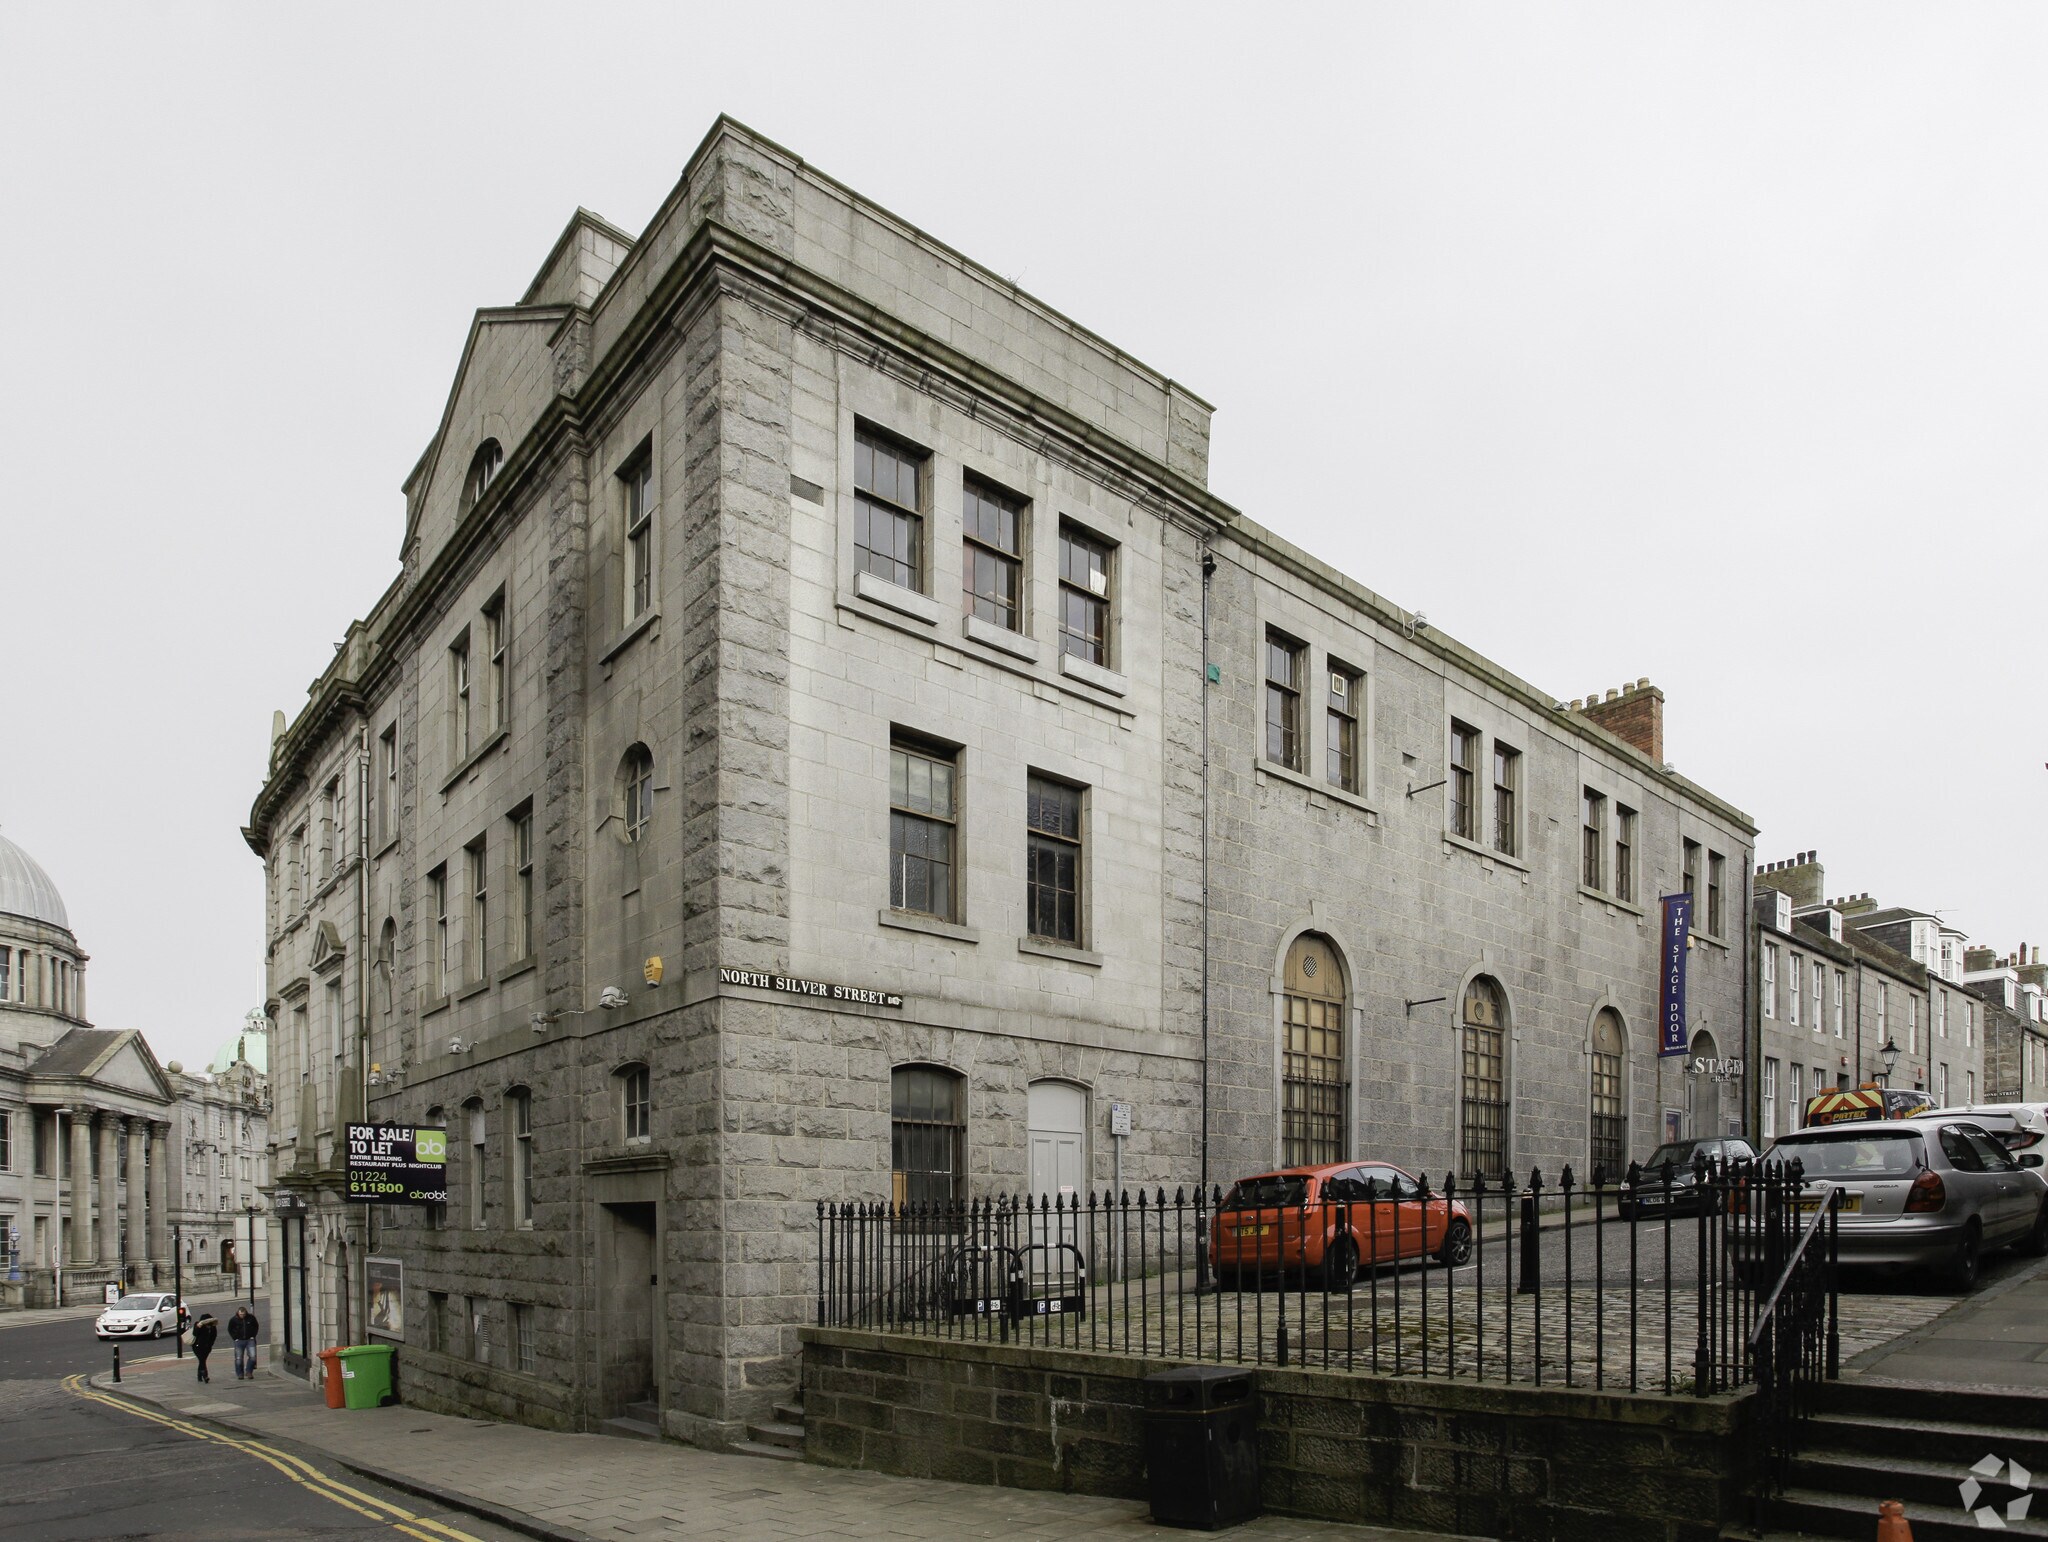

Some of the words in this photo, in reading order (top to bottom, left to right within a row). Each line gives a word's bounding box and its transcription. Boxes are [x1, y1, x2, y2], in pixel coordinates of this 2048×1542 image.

[1674, 907, 1683, 936] THE
[1671, 945, 1679, 994] STAGE
[720, 969, 770, 988] NORTH
[776, 977, 828, 996] SILVER
[834, 985, 885, 1005] STREET
[1670, 1003, 1679, 1043] DOOR
[1833, 1110, 1868, 1120] PIRTEK
[349, 1126, 374, 1140] FOR
[379, 1128, 414, 1142] SALE/
[350, 1141, 367, 1154] TO
[371, 1141, 393, 1155] LET
[350, 1171, 387, 1182] 01224
[350, 1182, 404, 1193] 611800
